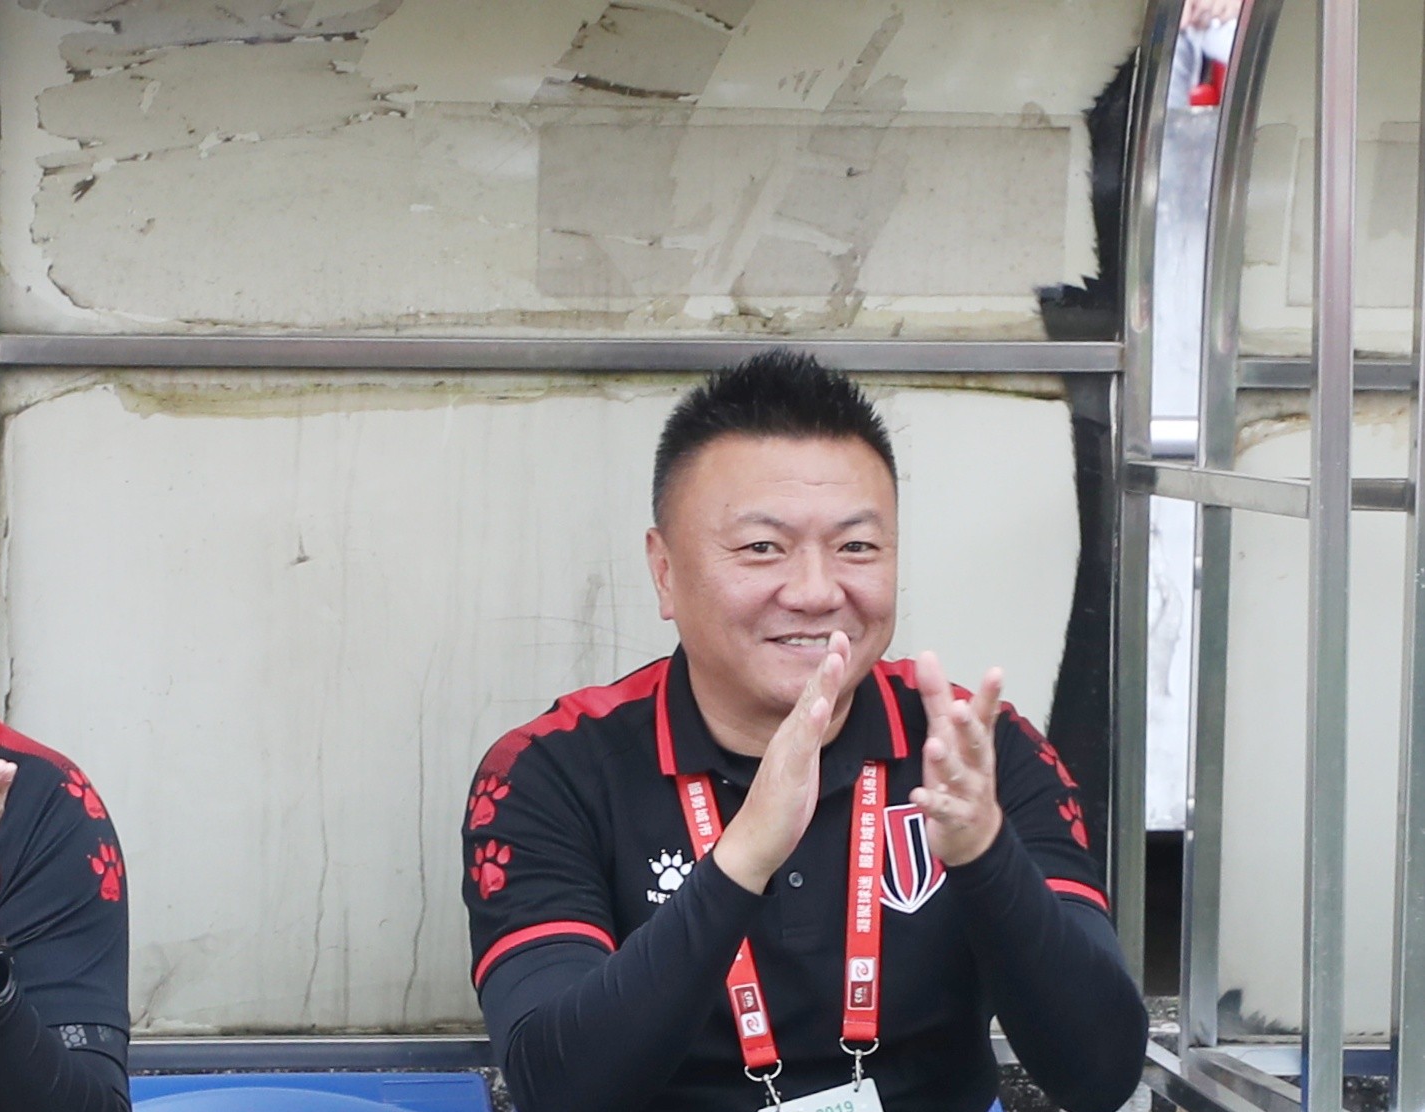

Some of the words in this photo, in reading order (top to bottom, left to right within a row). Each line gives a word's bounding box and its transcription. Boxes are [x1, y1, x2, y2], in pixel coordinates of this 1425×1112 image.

[687, 781, 713, 836] 服务城市
[861, 761, 877, 805] 弘扬足
[858, 812, 876, 868] 服务城市
[646, 890, 671, 904] KE
[856, 876, 874, 933] 凝聚球迷
